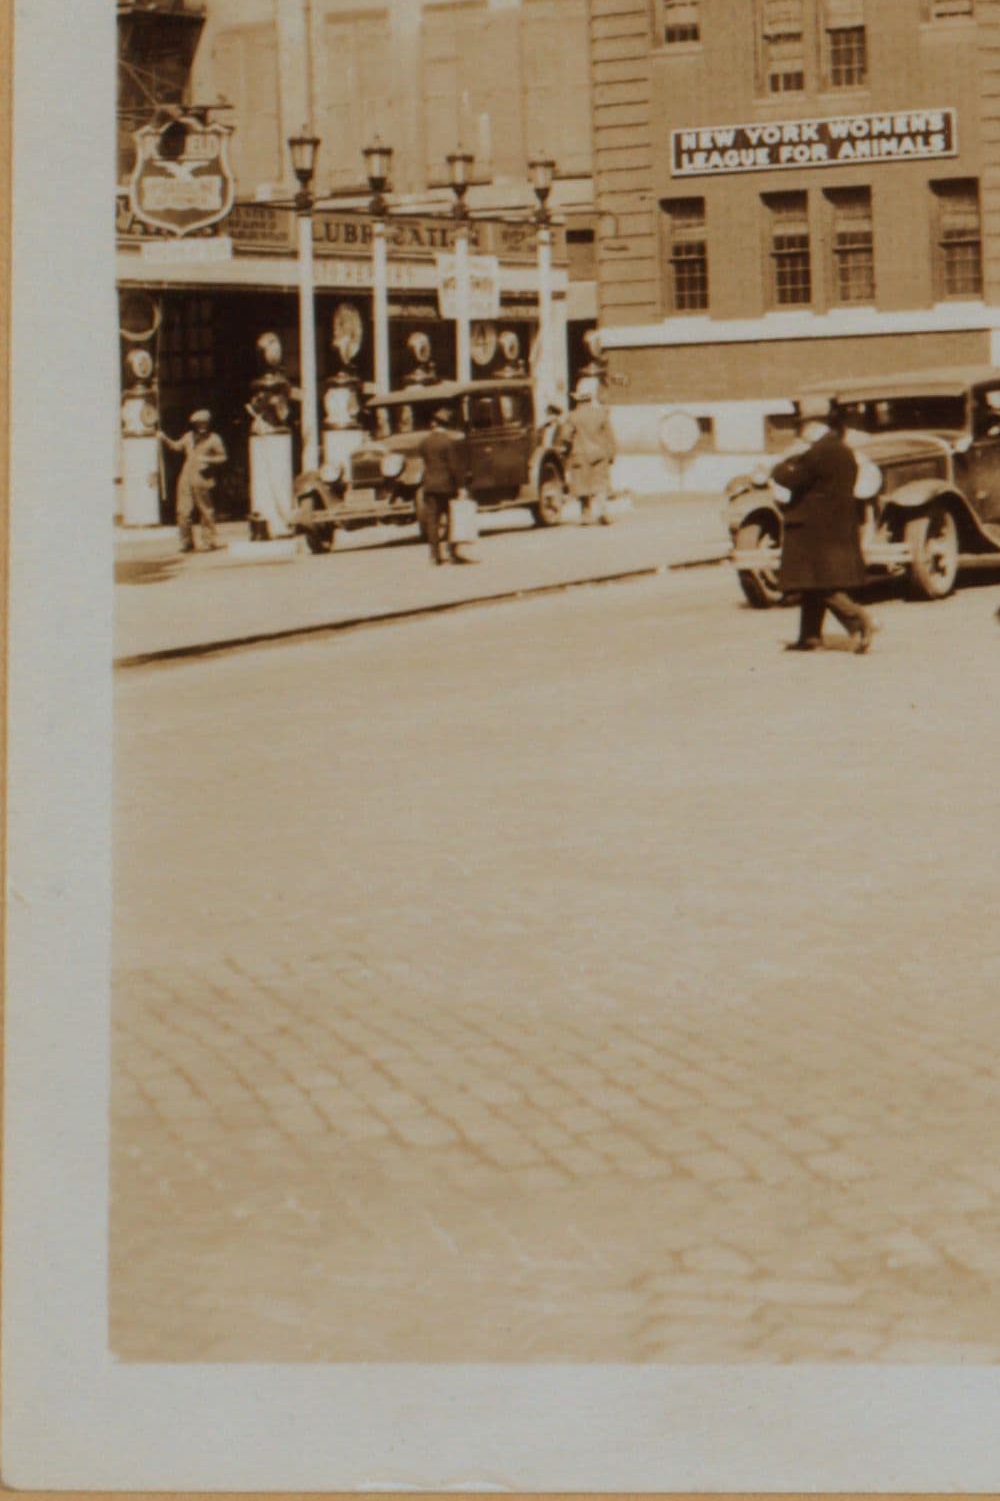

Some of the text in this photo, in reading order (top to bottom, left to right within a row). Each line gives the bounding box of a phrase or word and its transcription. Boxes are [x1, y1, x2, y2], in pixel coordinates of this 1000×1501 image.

[681, 129, 736, 150] NEW
[743, 121, 820, 146] YORK
[681, 133, 945, 171] LEAGUE FOR ANIMALS
